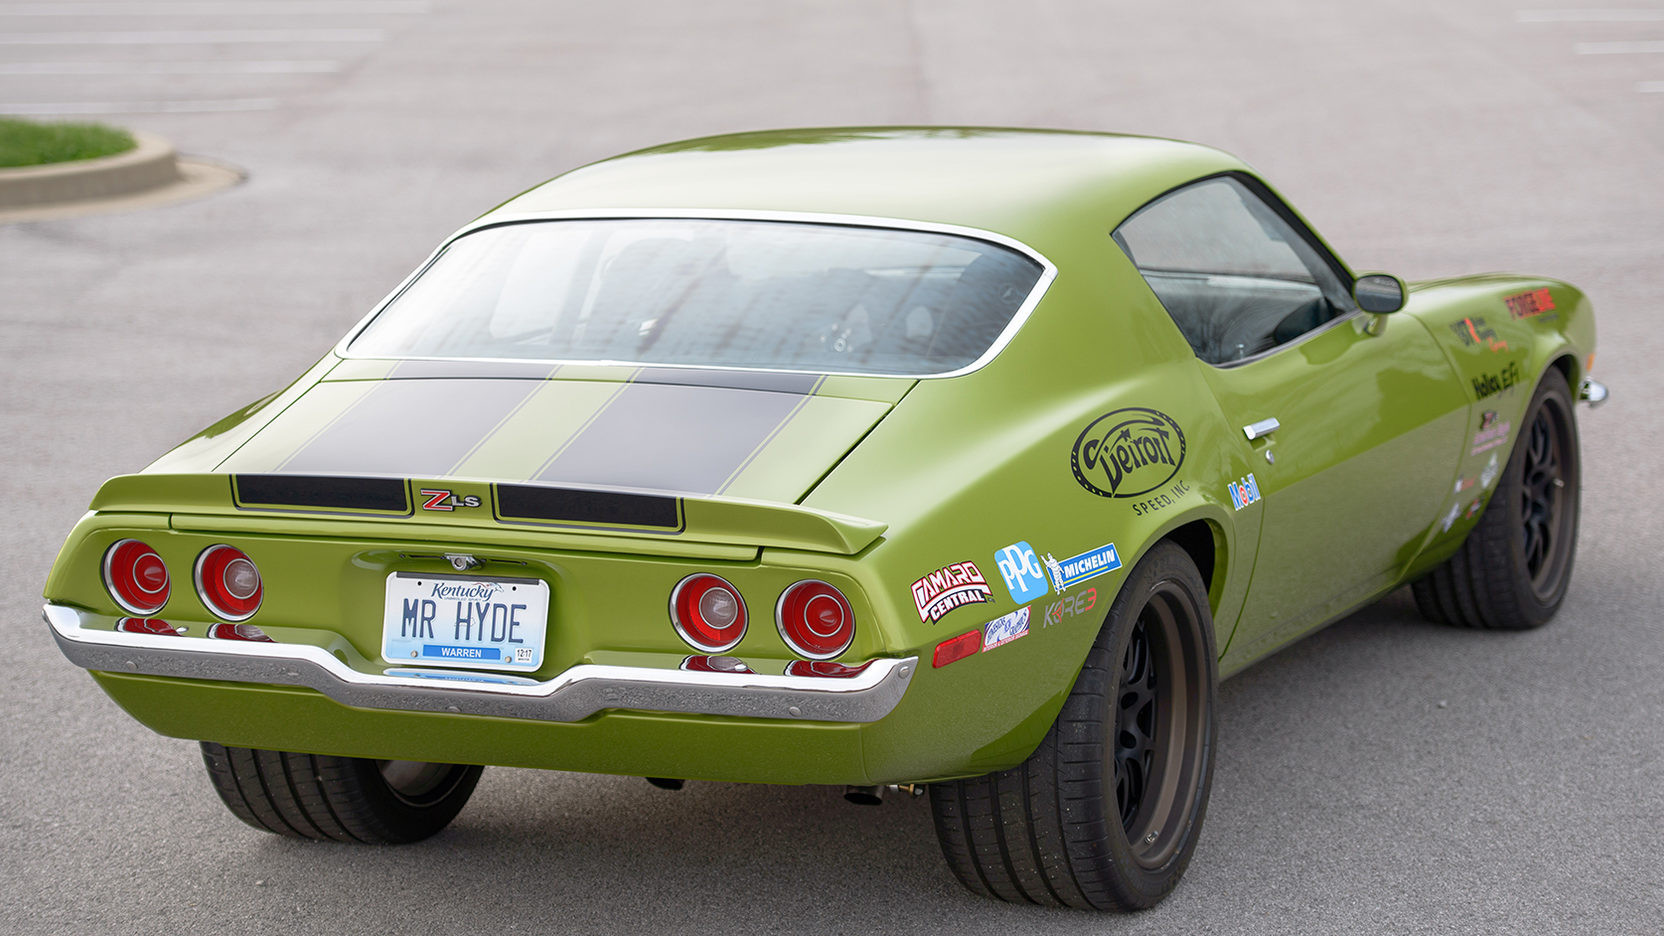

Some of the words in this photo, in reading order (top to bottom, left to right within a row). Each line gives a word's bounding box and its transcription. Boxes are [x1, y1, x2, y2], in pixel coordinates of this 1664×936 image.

[1083, 414, 1176, 494] Detroit
[1227, 472, 1261, 511] Mobil
[998, 544, 1043, 593] PPG
[1063, 549, 1116, 579] MICHELIN
[431, 582, 495, 601] Kentucky
[911, 561, 989, 622] CAMARO
[930, 589, 985, 622] CENTRAL
[401, 598, 437, 639] MR
[455, 601, 528, 644] HYDE
[441, 647, 482, 658] WARREN
